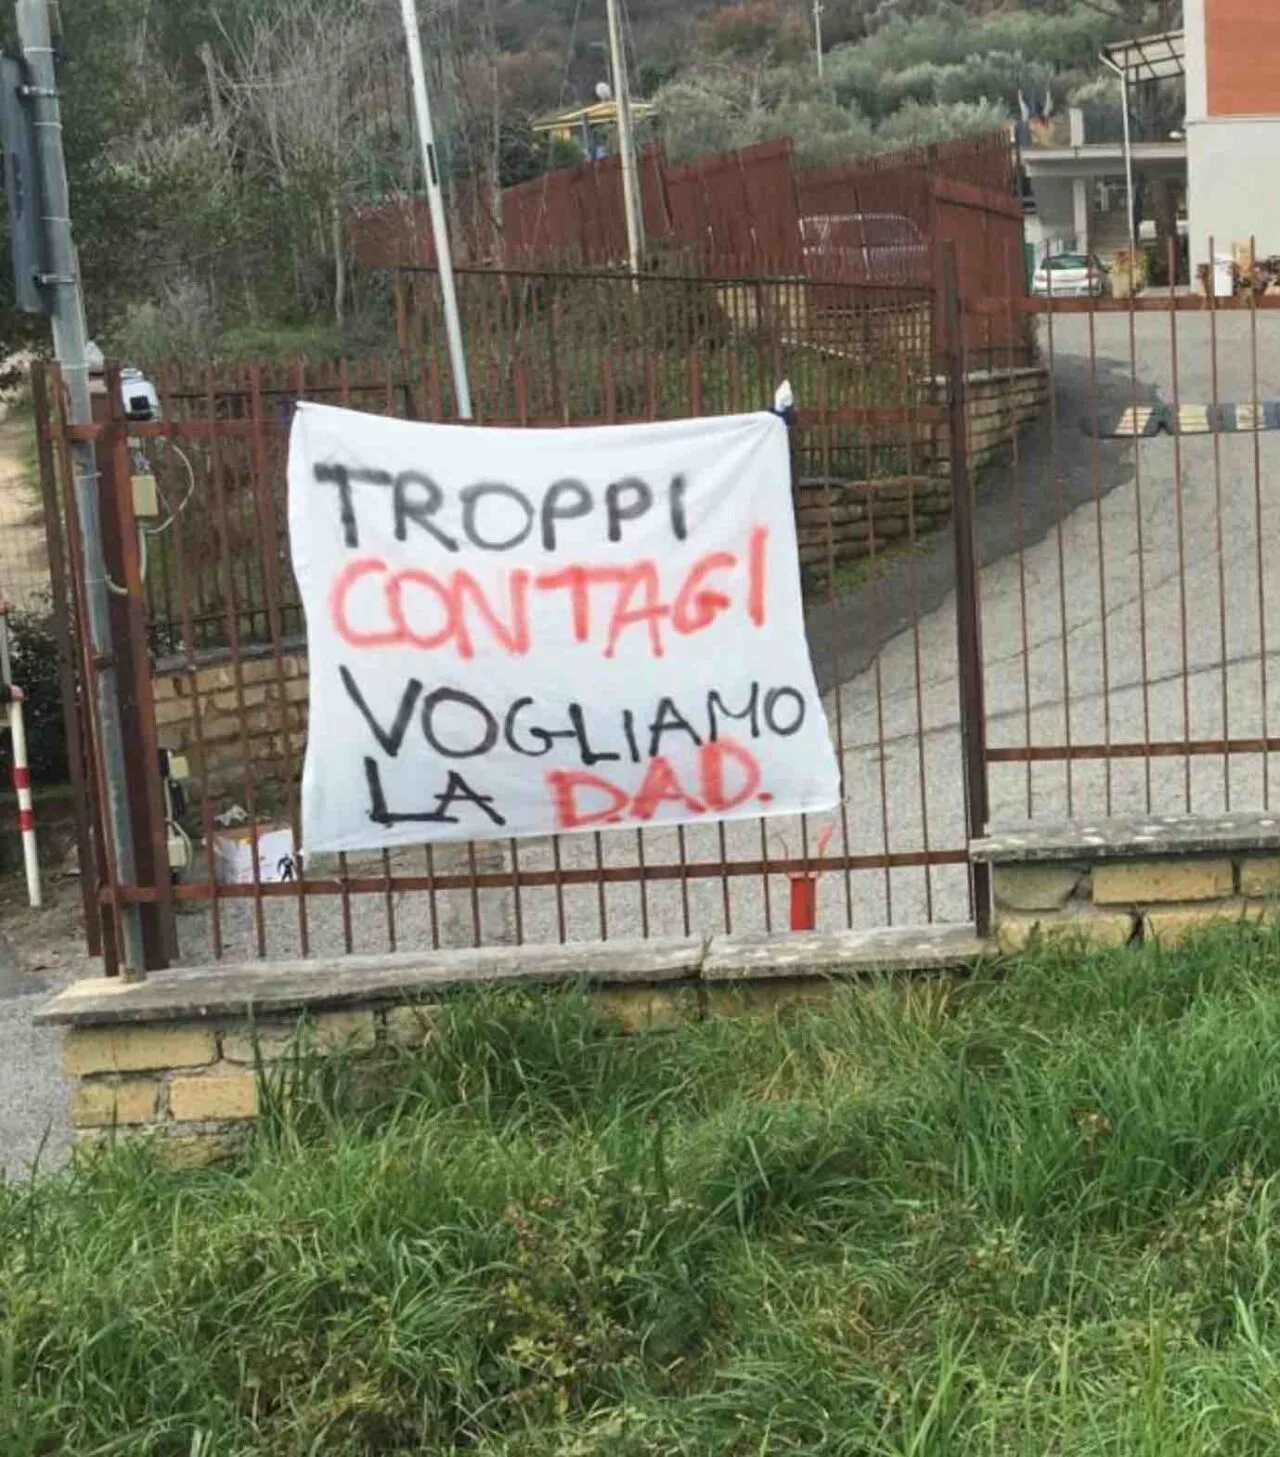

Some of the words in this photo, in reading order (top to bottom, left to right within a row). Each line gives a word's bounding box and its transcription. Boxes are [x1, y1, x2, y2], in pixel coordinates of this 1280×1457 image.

[313, 462, 688, 552] TROPPI
[330, 525, 769, 660] CONTAGI
[338, 664, 807, 765] VOGLIAMO
[364, 756, 506, 828] LA
